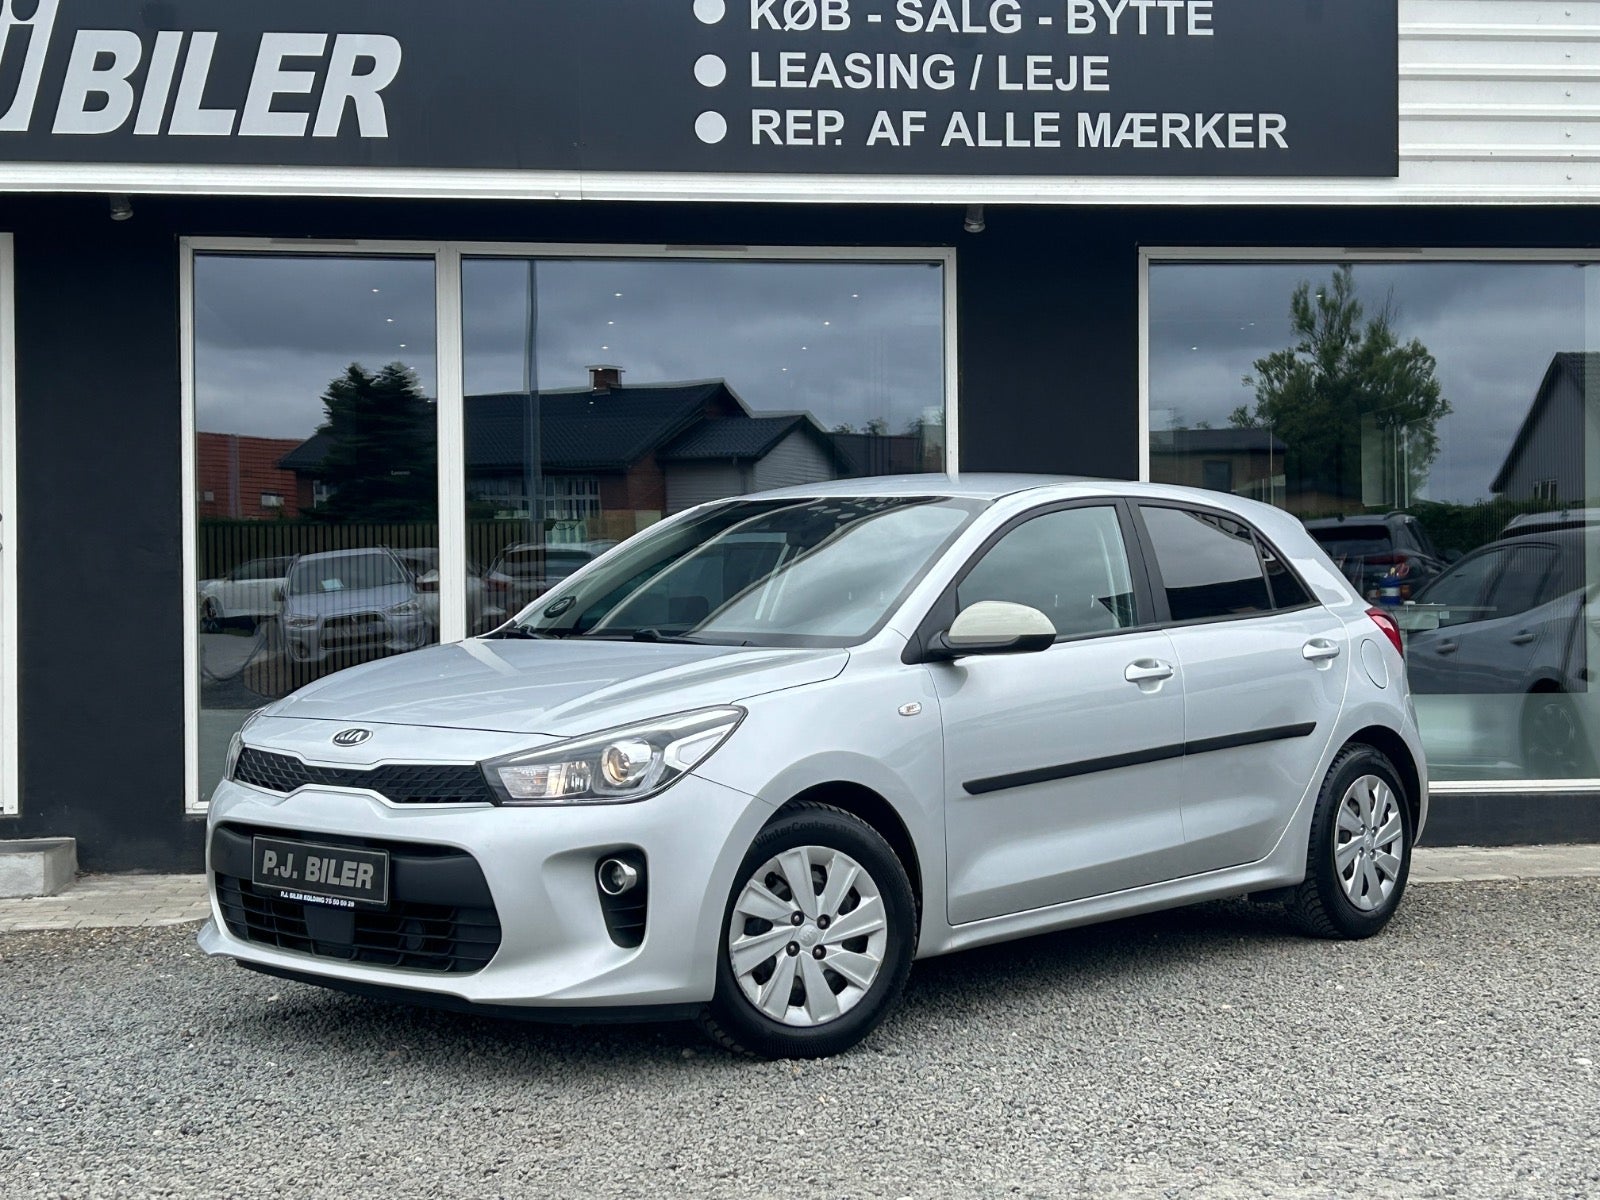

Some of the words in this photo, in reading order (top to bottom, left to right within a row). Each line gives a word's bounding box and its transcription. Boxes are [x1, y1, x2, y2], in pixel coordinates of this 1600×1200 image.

[751, 0, 851, 31] KØB
[867, 14, 882, 23] -
[895, 0, 1022, 33] SALG
[1038, 16, 1053, 25] -
[1067, 0, 1215, 36] BYTTE
[51, 29, 402, 138] BILER
[751, 52, 956, 90] LEASING
[969, 54, 984, 91] /
[998, 55, 1110, 92] LEJE
[751, 109, 845, 146] REP.
[866, 111, 927, 146] AF
[941, 112, 1061, 148] ALLE
[1077, 113, 1289, 149] MÆRKER
[262, 850, 298, 879] P.J.
[304, 855, 374, 889] BILER
[289, 892, 303, 900] BILER
[303, 894, 325, 904] KOLDING
